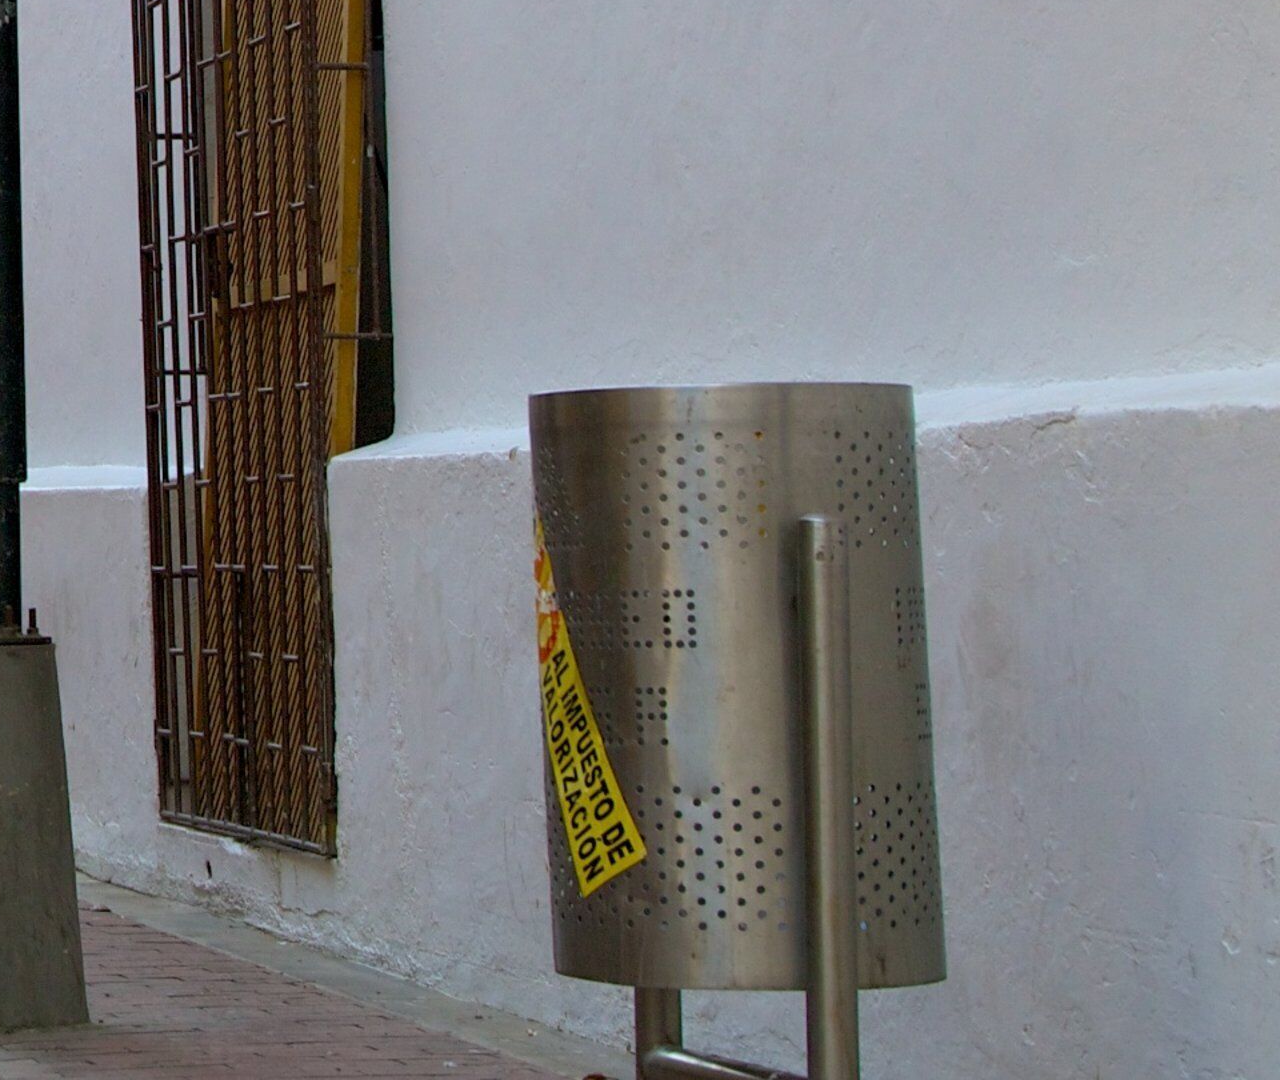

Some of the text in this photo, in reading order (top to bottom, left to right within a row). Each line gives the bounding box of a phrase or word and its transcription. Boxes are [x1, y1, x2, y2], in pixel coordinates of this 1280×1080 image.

[543, 664, 605, 883] VALORIZACIÓN
[552, 649, 634, 866] AL IMPUESTO DE
